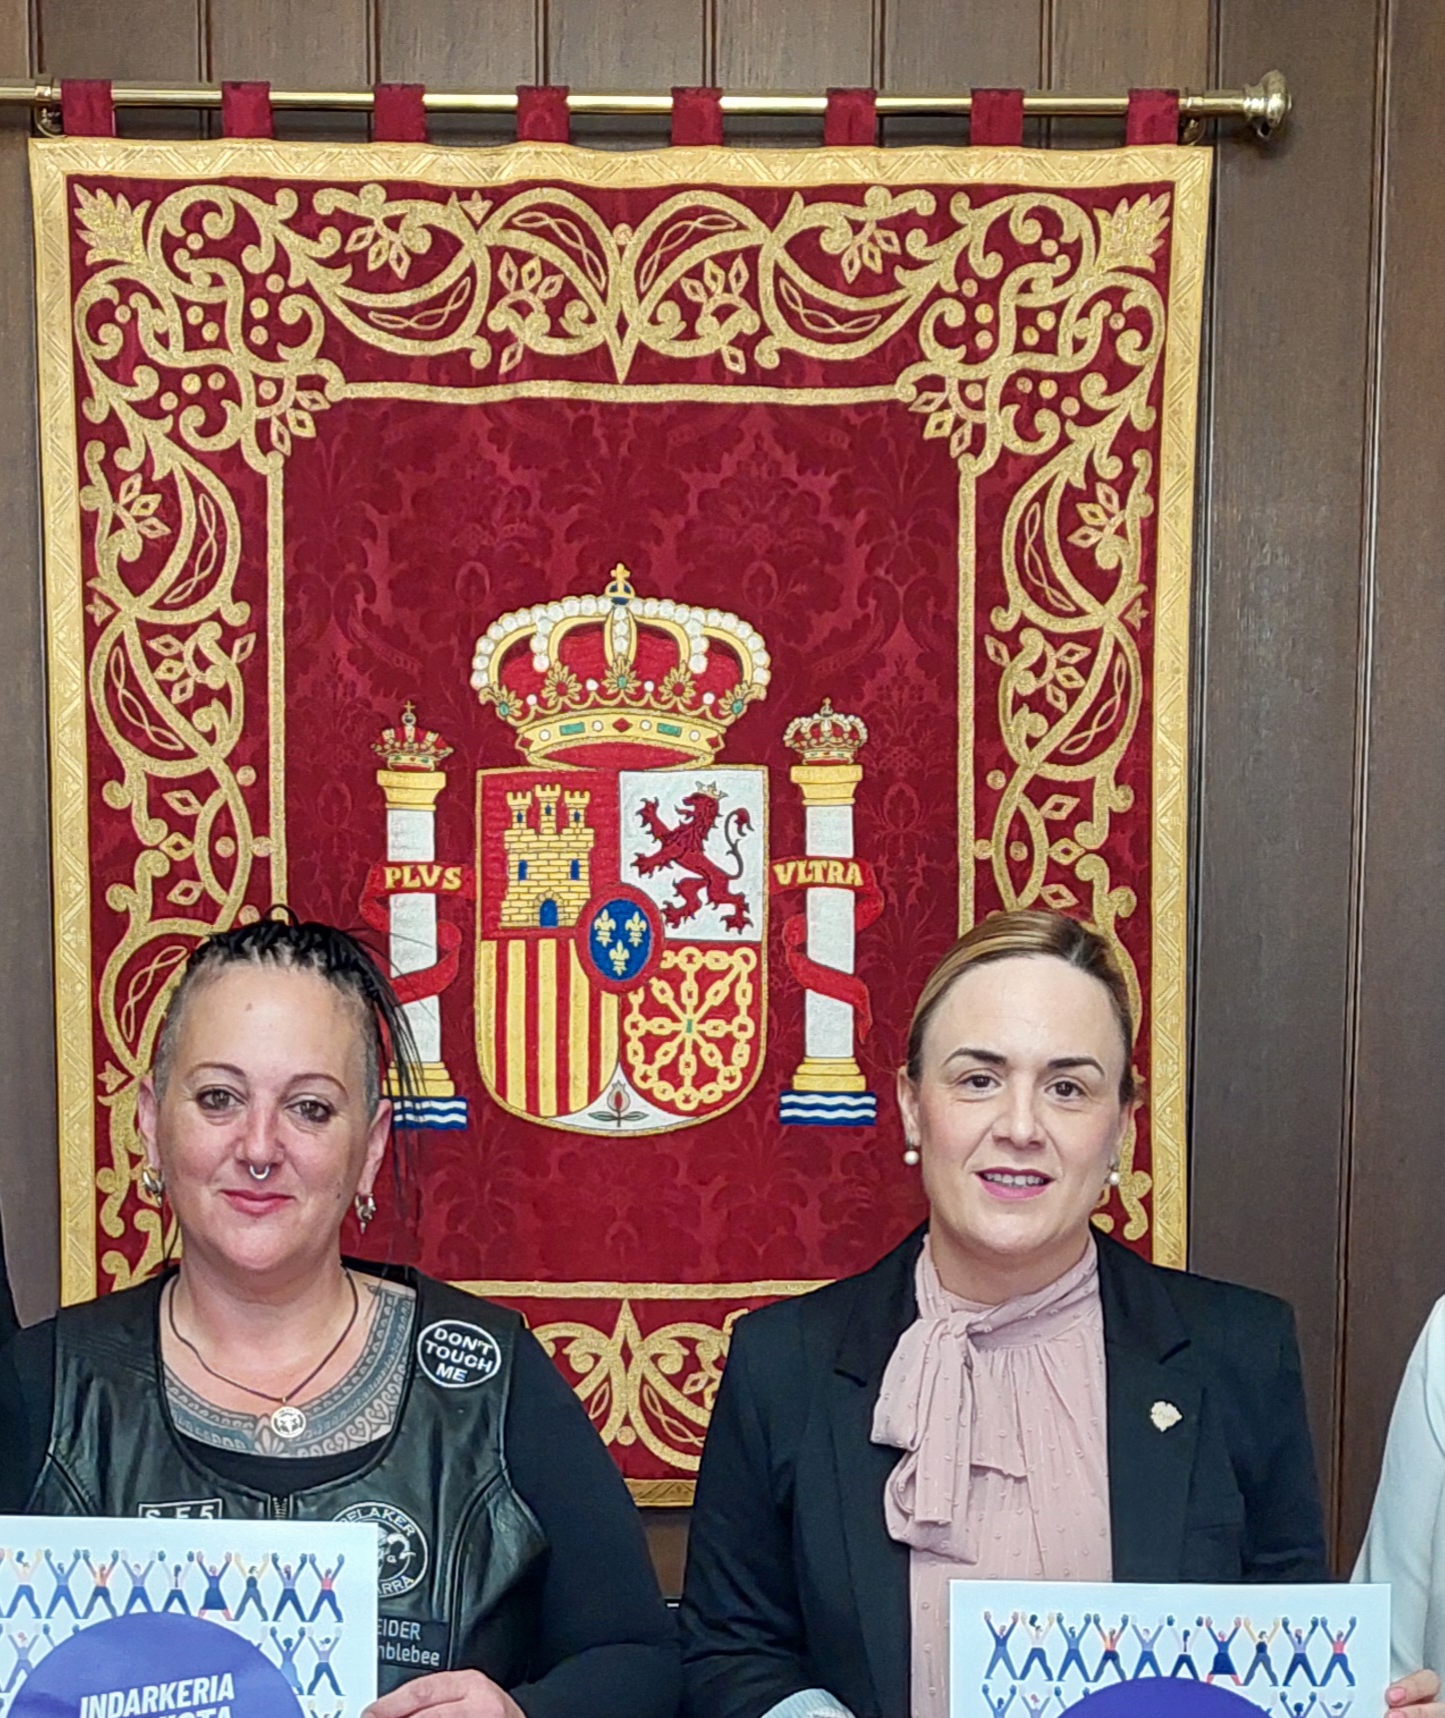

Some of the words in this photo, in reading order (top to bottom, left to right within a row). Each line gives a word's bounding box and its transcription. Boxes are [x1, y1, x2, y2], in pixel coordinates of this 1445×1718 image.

[383, 864, 462, 890] PLVS
[773, 860, 864, 886] VLTRA
[434, 1328, 493, 1355] DON'T
[425, 1339, 494, 1373] TOUCH
[436, 1363, 468, 1382] ME
